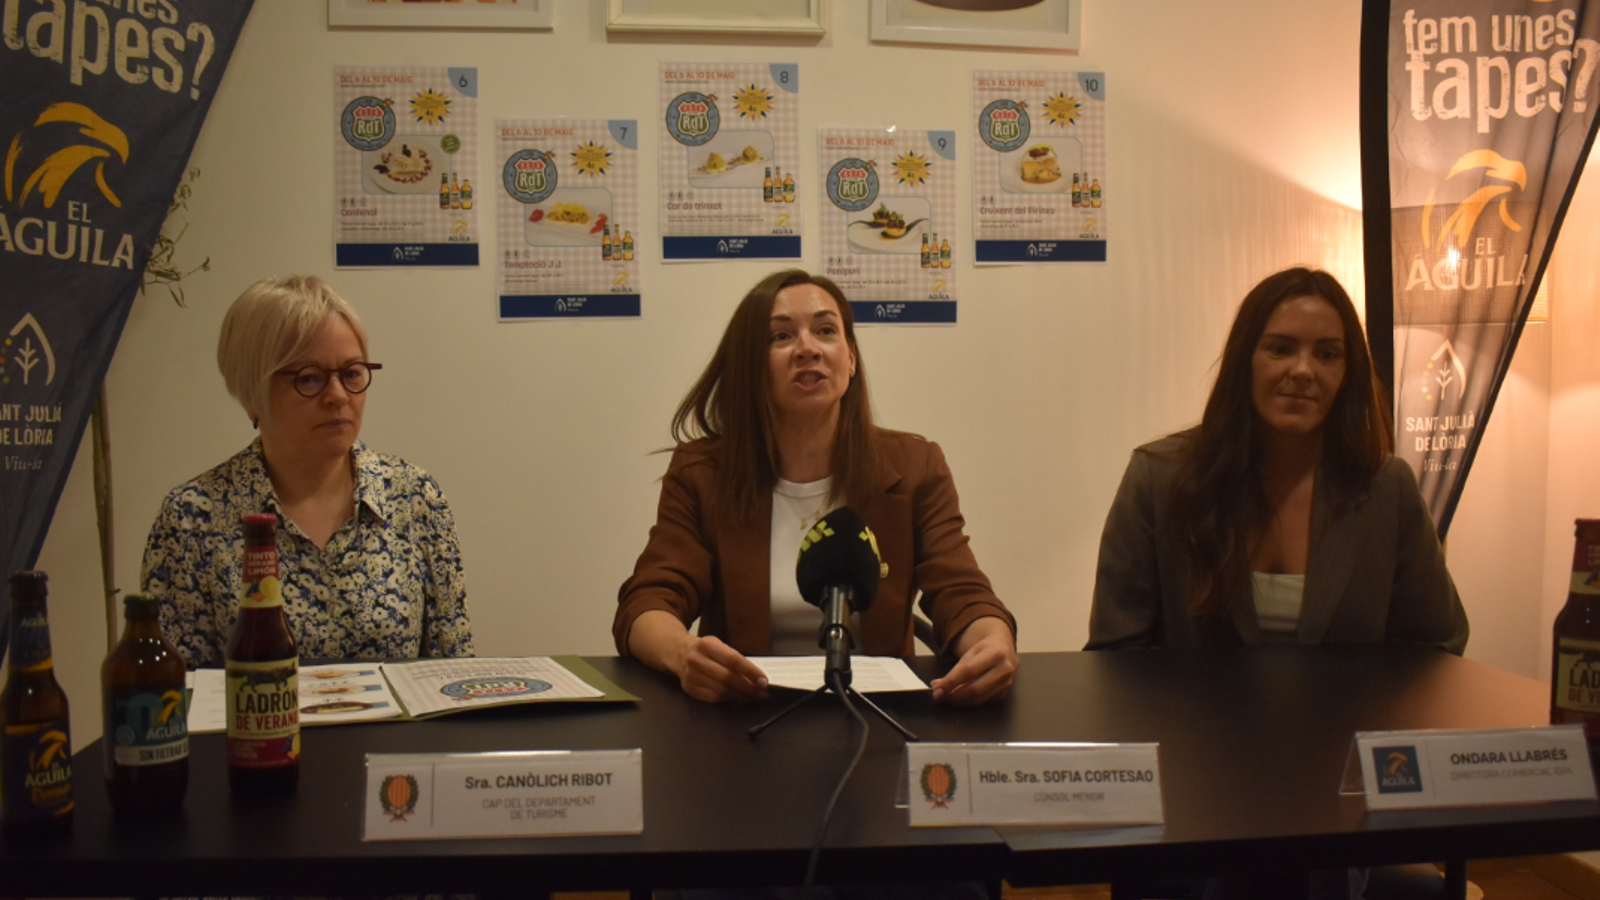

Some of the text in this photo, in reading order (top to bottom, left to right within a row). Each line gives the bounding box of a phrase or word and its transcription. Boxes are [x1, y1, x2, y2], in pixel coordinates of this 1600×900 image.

[1402, 9, 1576, 54] fem unes
[3, 0, 216, 101] tapes?
[458, 75, 468, 88] 6
[780, 70, 789, 84] 8
[1084, 79, 1099, 92] 10
[1405, 38, 1600, 133] tapes?
[357, 119, 381, 134] RdT
[682, 115, 706, 130] RdT
[994, 122, 1016, 136] RdT
[619, 127, 628, 140] 7
[938, 137, 947, 151] 9
[519, 173, 542, 187] RdT
[842, 181, 865, 195] RdT
[68, 201, 92, 223] EL
[1014, 206, 1026, 215] del
[1475, 237, 1494, 255] EL
[0, 403, 22, 421] NT
[1405, 410, 1475, 432] SANT JULIÀ
[14, 423, 53, 445] LÒRIA
[1415, 433, 1466, 452] DE LÒRIA
[1569, 667, 1600, 689] LAD
[235, 688, 298, 713] LADRÓN
[236, 715, 251, 730] DE
[139, 749, 155, 762] SIN
[1450, 746, 1568, 765] ONDARA LLABRÉS
[465, 772, 613, 789] Sra. CANÒLICH RIBOT
[979, 770, 1153, 783] Hble. Sra. SOFIA CORTESAO
[1450, 768, 1501, 781] DIRECTORA
[1502, 767, 1551, 778] COMERCIAL
[482, 795, 596, 809] CAP DEL DEPARTAMENT
[1072, 792, 1105, 802] MENOR
[510, 808, 568, 820] DE TURISME
